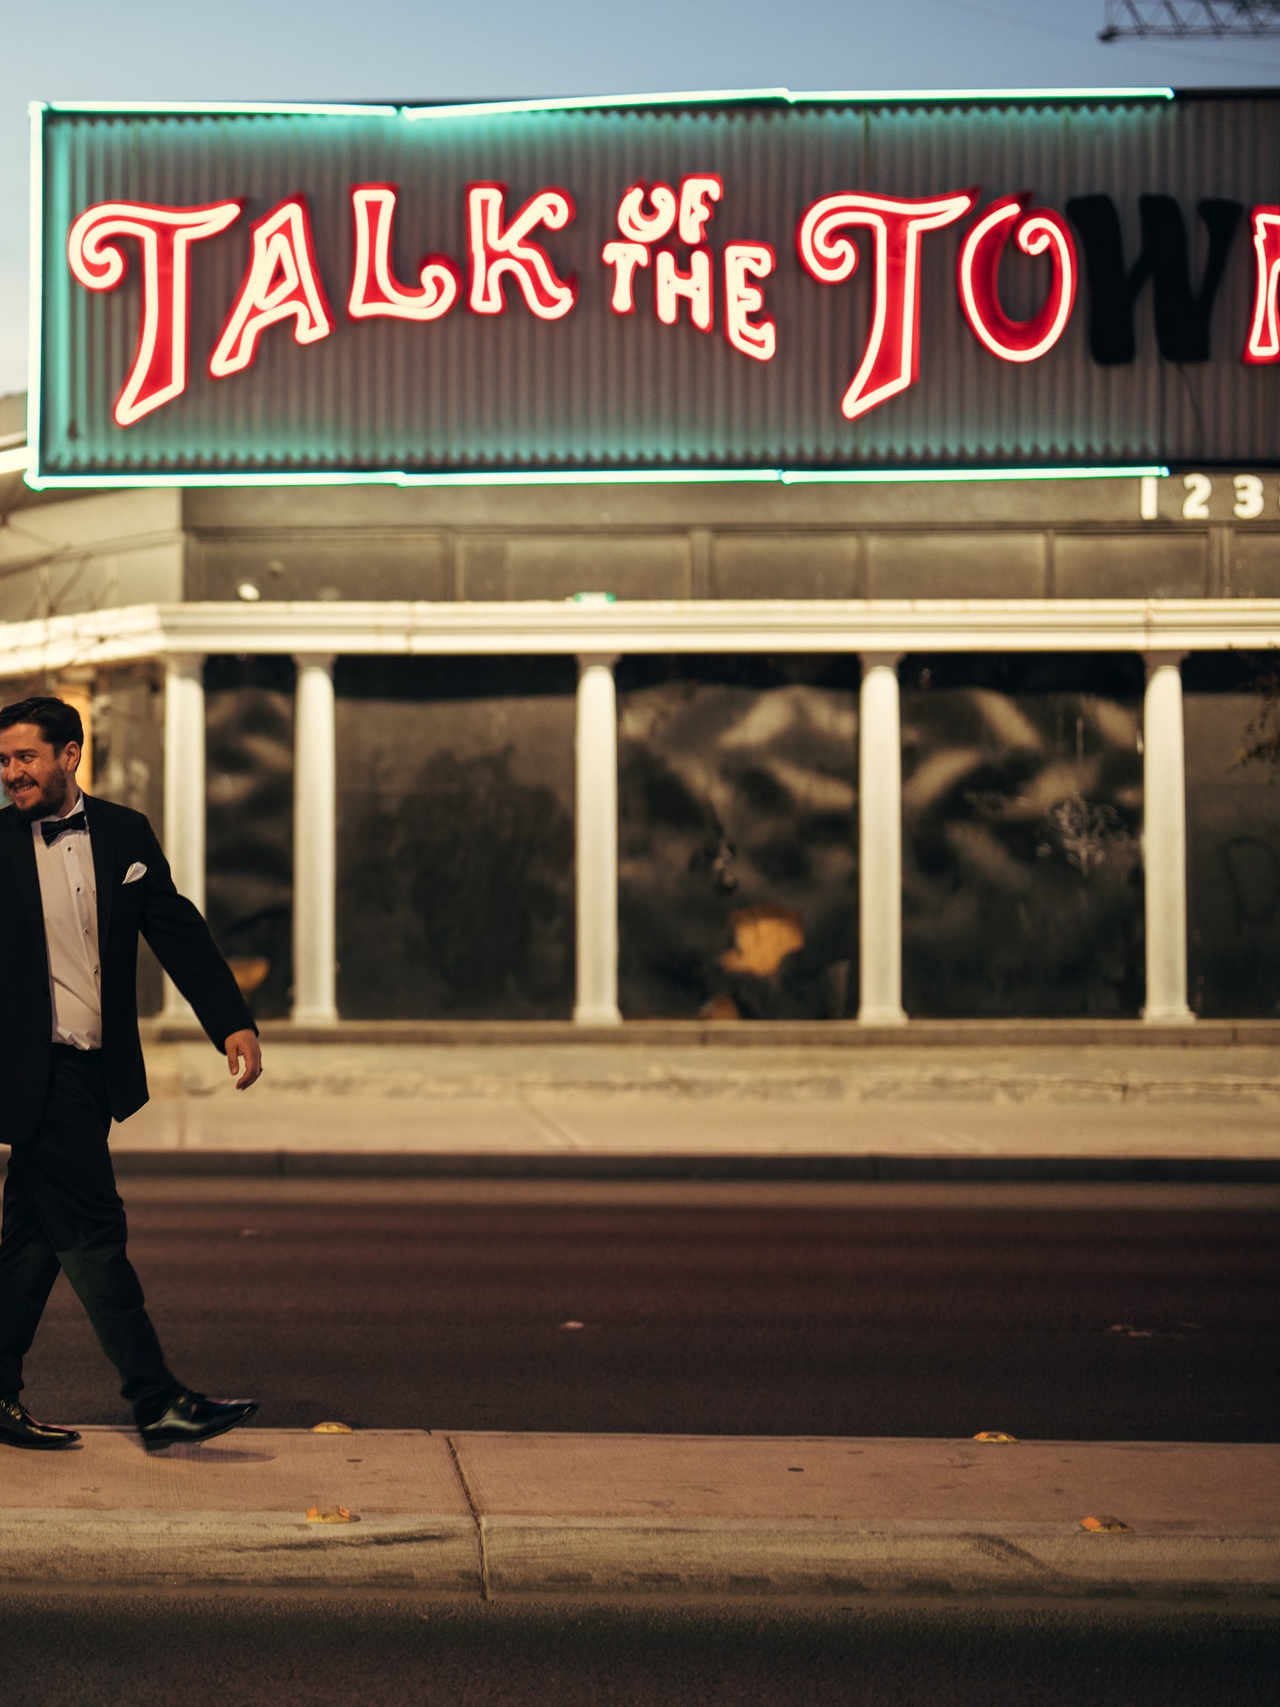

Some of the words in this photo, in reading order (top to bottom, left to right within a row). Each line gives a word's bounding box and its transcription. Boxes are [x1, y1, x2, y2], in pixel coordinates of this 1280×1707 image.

[616, 172, 724, 246] OF
[67, 180, 579, 427] TALK
[602, 239, 777, 362] THE
[1140, 473, 1280, 520] 123
